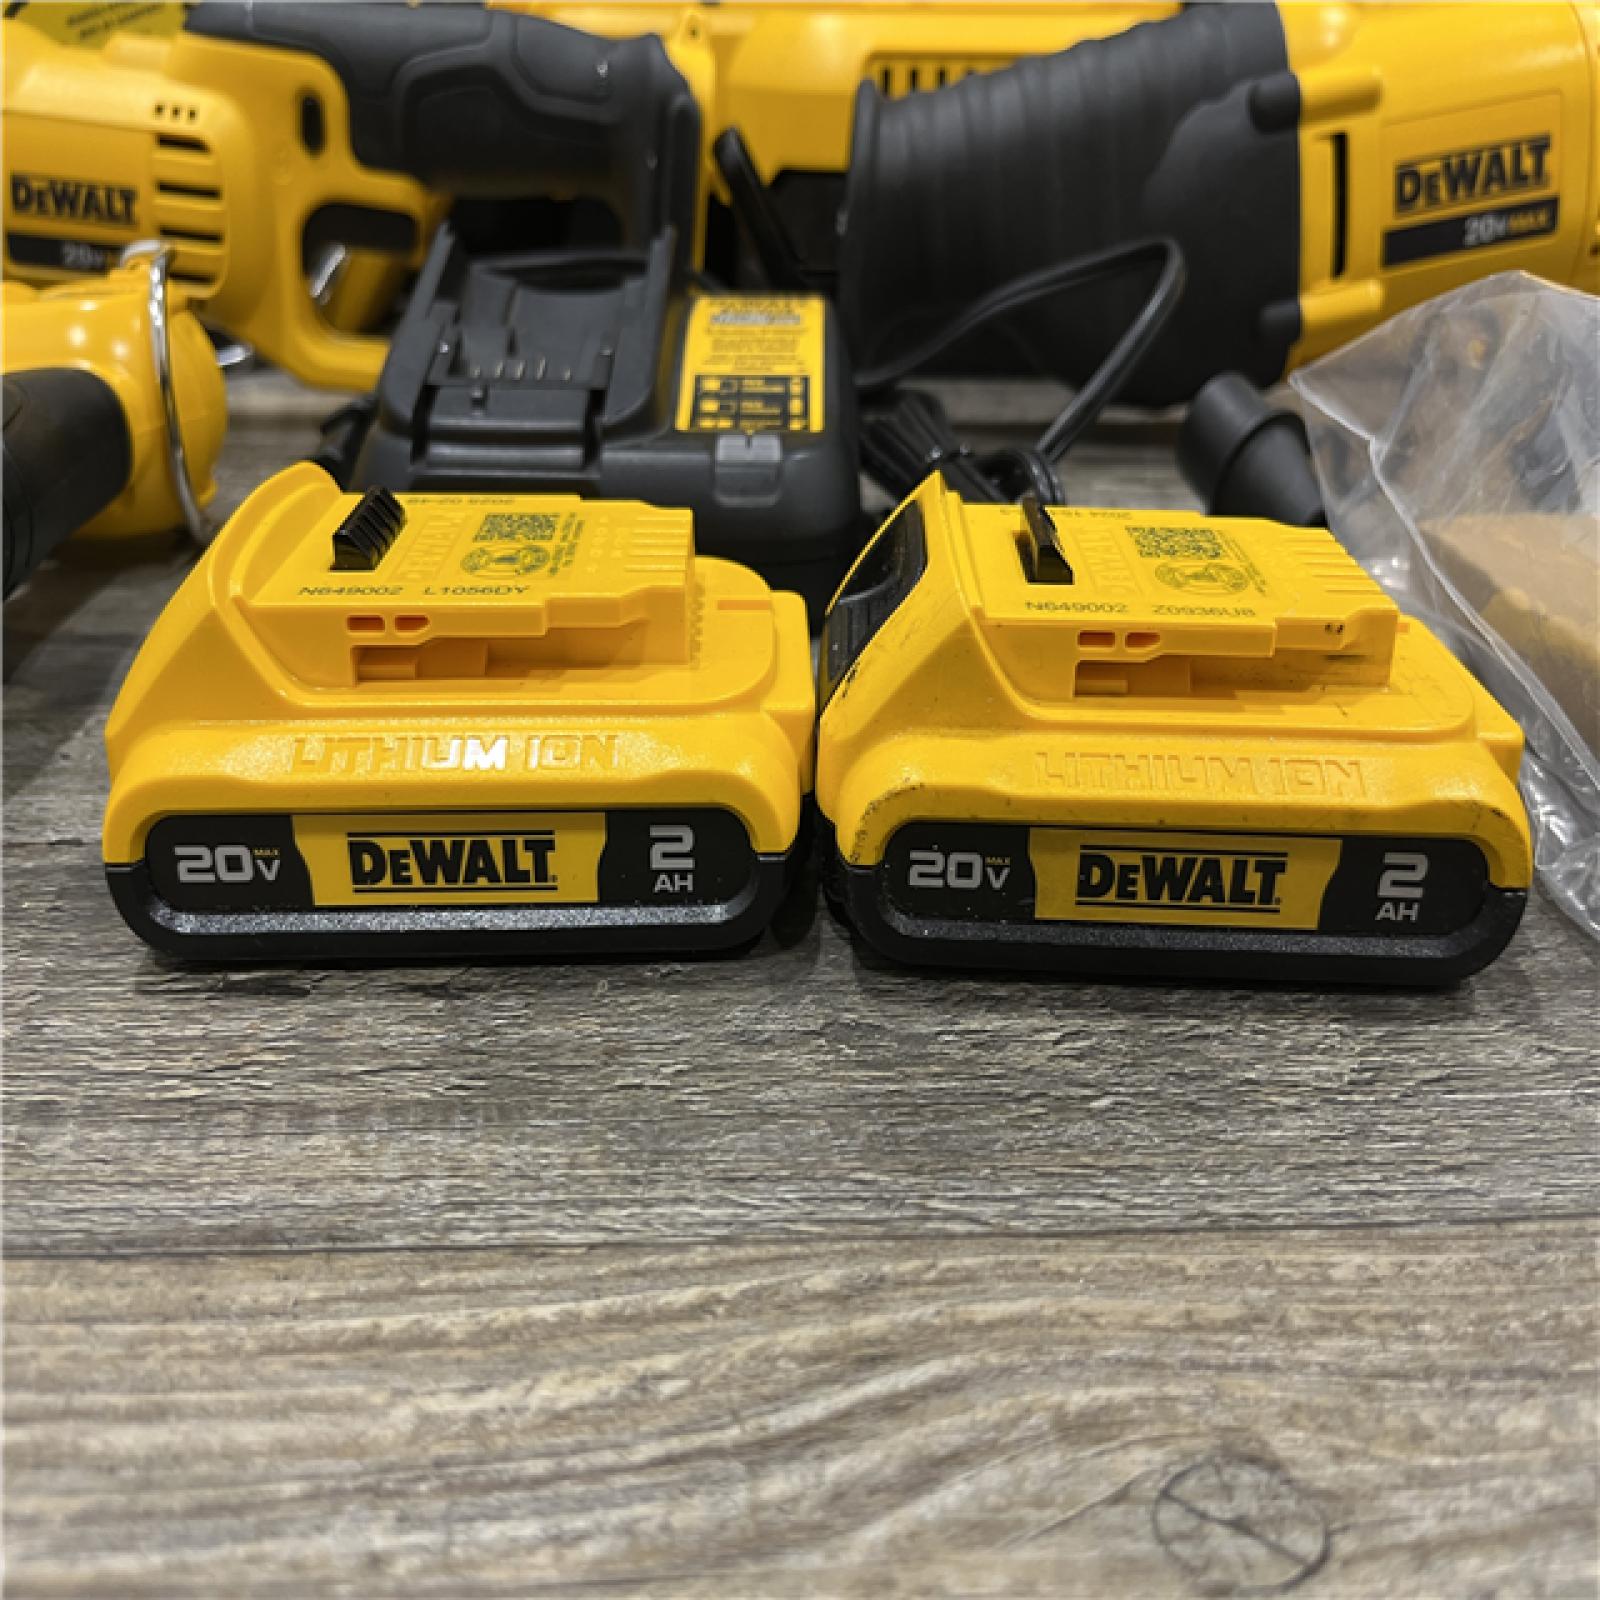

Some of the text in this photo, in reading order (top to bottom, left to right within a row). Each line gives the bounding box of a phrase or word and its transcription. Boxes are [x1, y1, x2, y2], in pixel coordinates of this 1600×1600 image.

[1395, 137, 1551, 206] DEWALT
[11, 174, 137, 223] DEWALT
[292, 734, 619, 773] LITHIUM ION
[1035, 751, 1369, 798] LITHIUM ION
[347, 837, 558, 887] DEWALT
[650, 824, 695, 871] 2
[653, 872, 694, 894] AH
[1077, 852, 1288, 906] DEWALT
[1377, 851, 1428, 899] 2
[1374, 901, 1420, 922] AH
